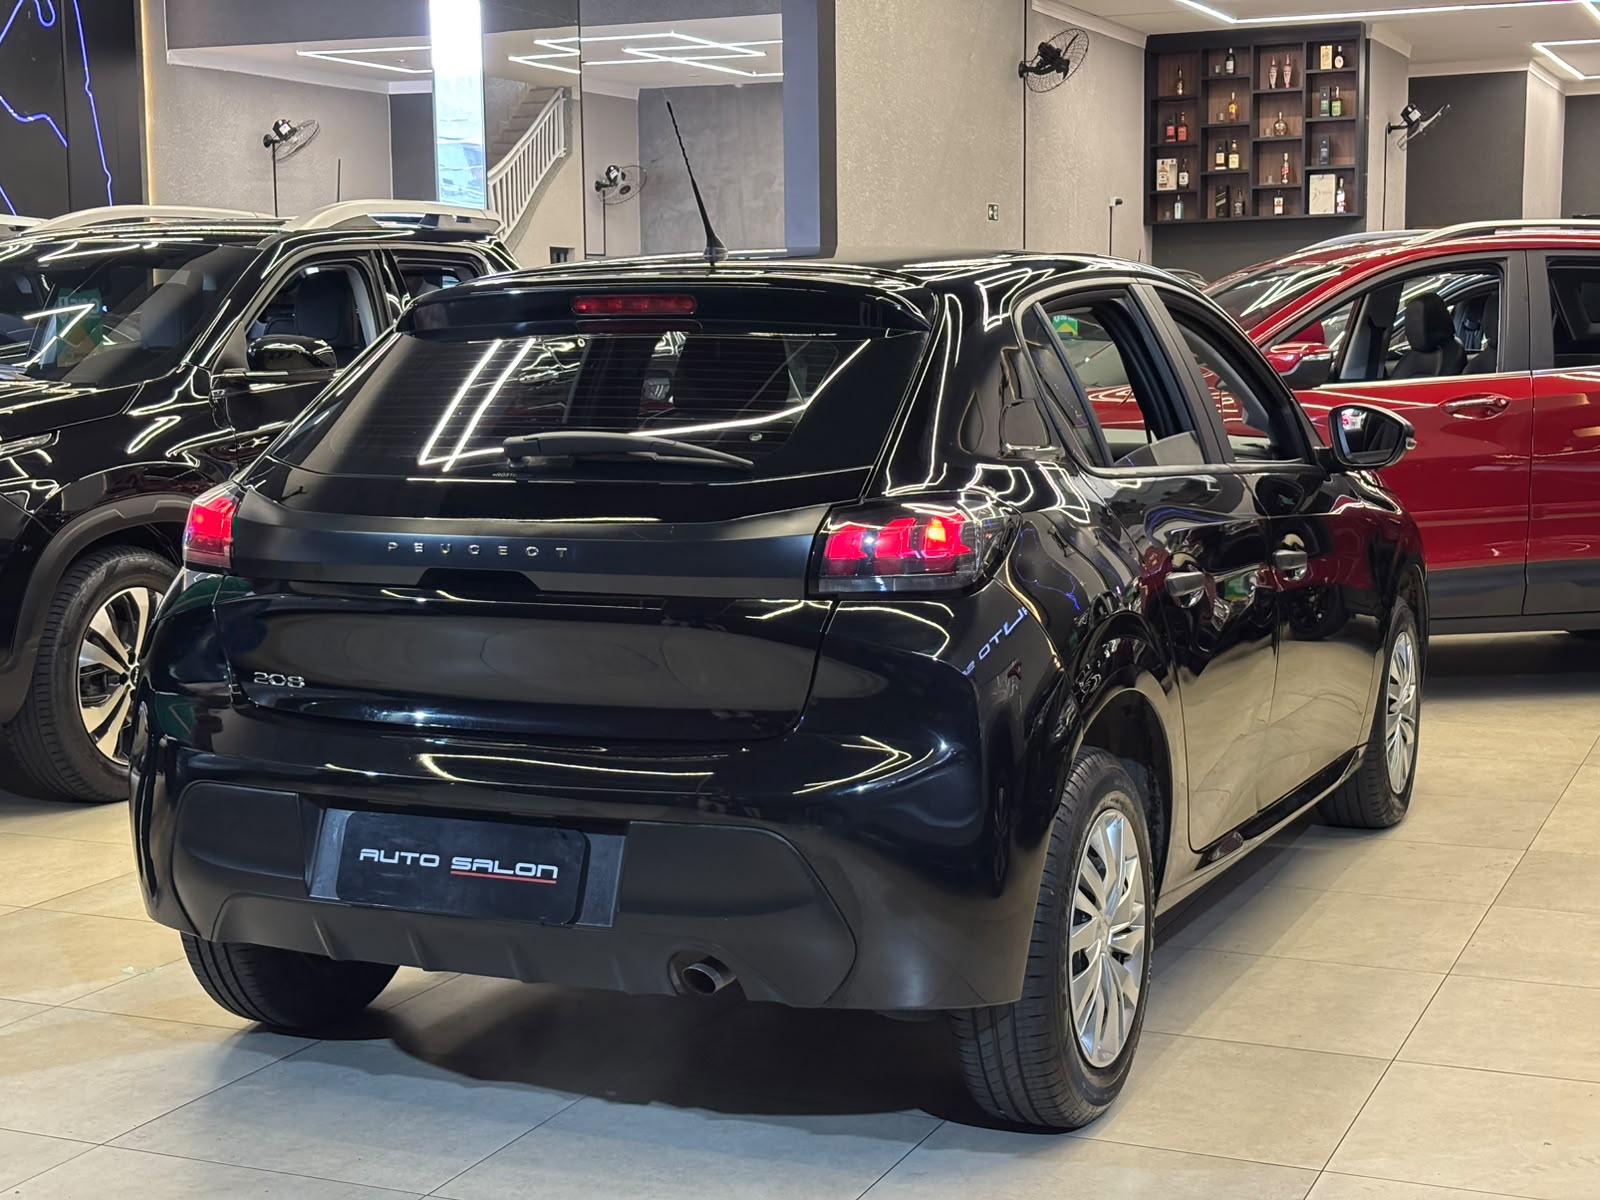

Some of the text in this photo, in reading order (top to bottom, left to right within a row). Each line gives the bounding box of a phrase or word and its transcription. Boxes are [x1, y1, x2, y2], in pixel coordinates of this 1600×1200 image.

[387, 541, 568, 558] PEUGEOT
[253, 671, 306, 689] 208
[359, 848, 559, 880] AUTO SALON
